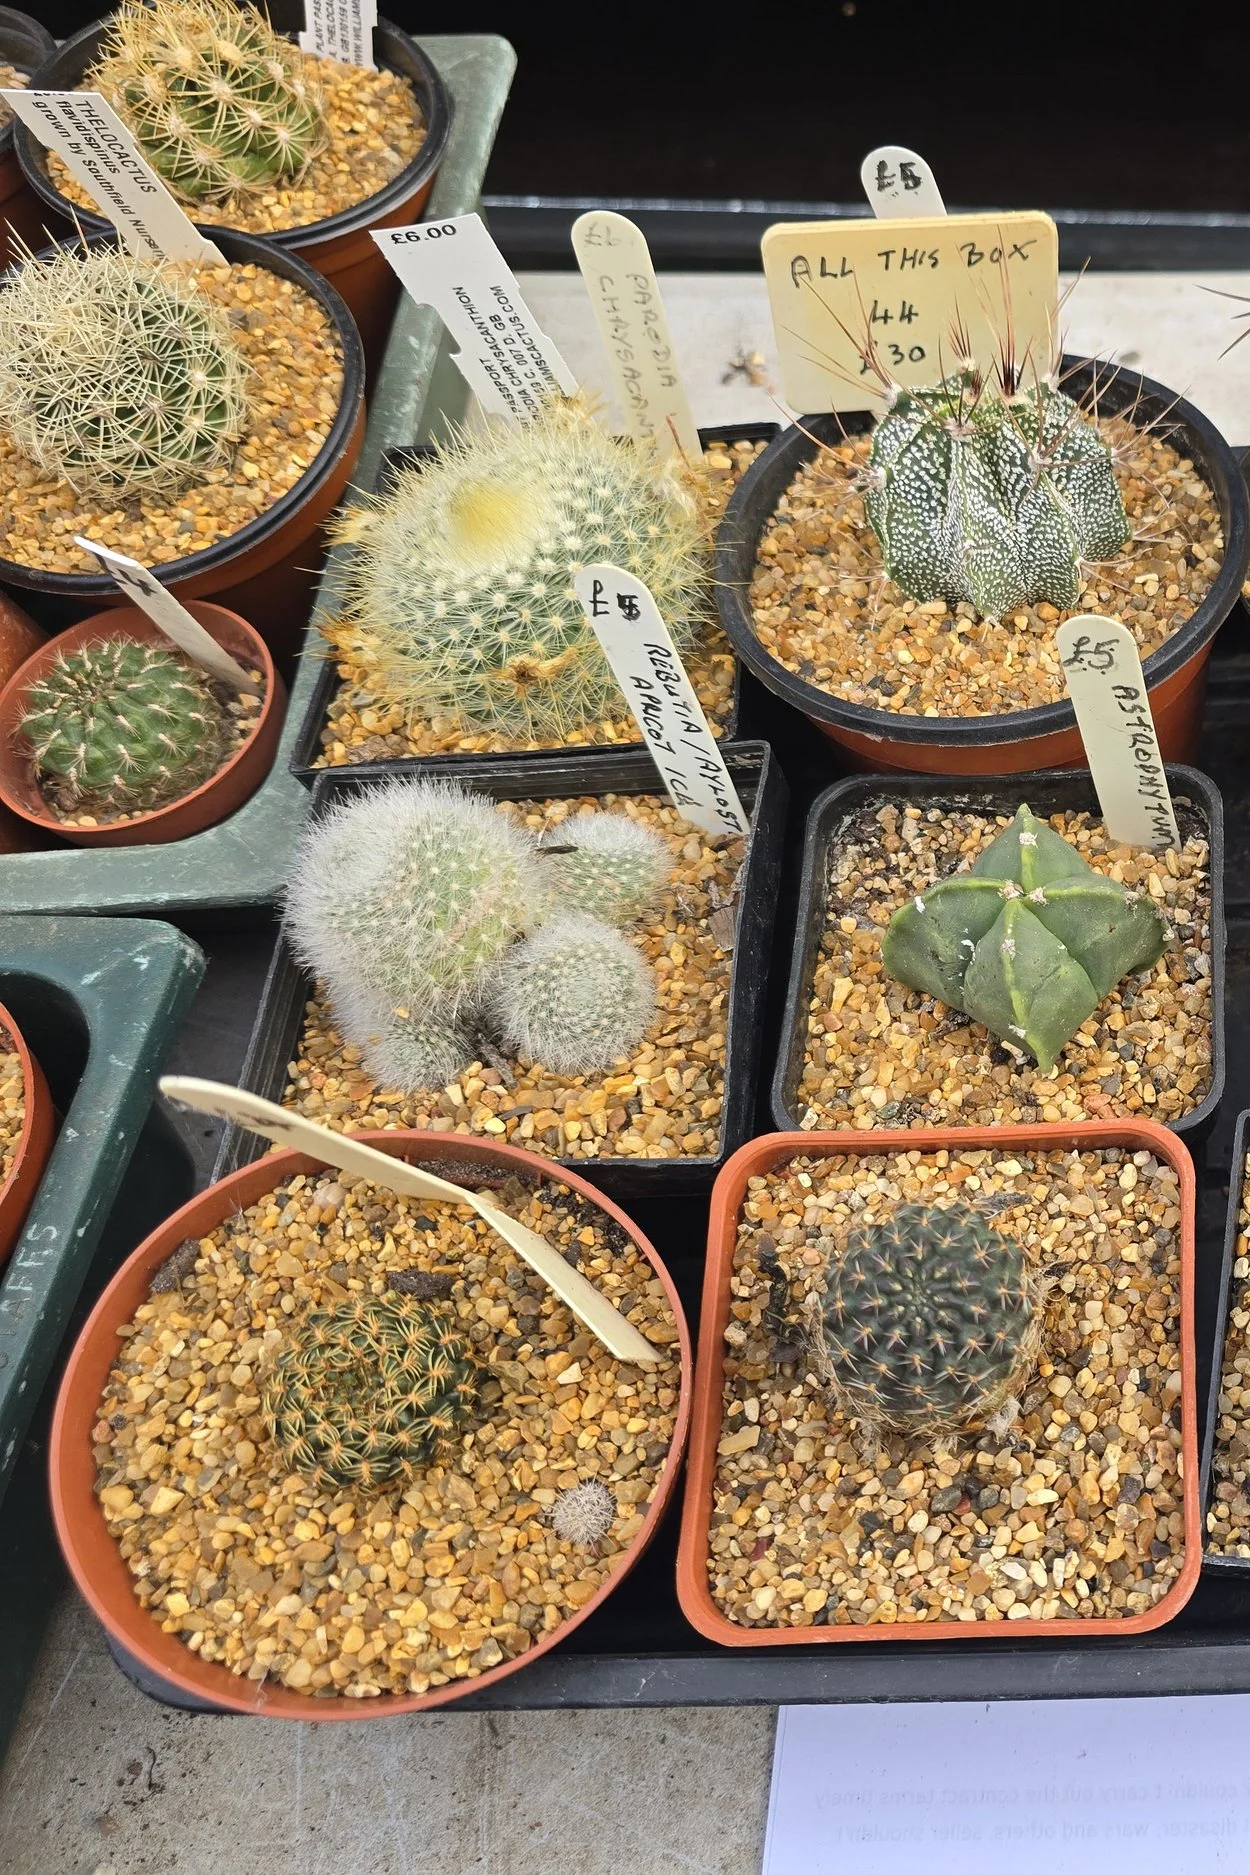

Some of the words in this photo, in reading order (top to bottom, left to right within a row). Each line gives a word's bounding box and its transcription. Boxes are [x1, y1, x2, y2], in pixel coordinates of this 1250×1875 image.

[326, 0, 336, 46] THELOCA
[32, 101, 71, 138] grown
[68, 142, 86, 156] by
[82, 159, 135, 215] Southfield
[55, 100, 121, 174] flavidispinus
[75, 100, 157, 194] THELOCACTUS
[391, 224, 457, 244] £6.00
[791, 255, 853, 289] ALL
[878, 248, 940, 271] THIS
[960, 239, 1038, 268] BOX
[452, 286, 522, 387] CHRYSACANTHION
[489, 314, 505, 331] GB
[503, 333, 516, 347] D.
[626, 273, 677, 388] PARODIA
[869, 300, 919, 325] 44
[510, 350, 528, 366] 007
[630, 676, 676, 755] APRICOT
[644, 643, 703, 734] REBUTIA
[1112, 685, 1176, 848] ASTROPHYTUM
